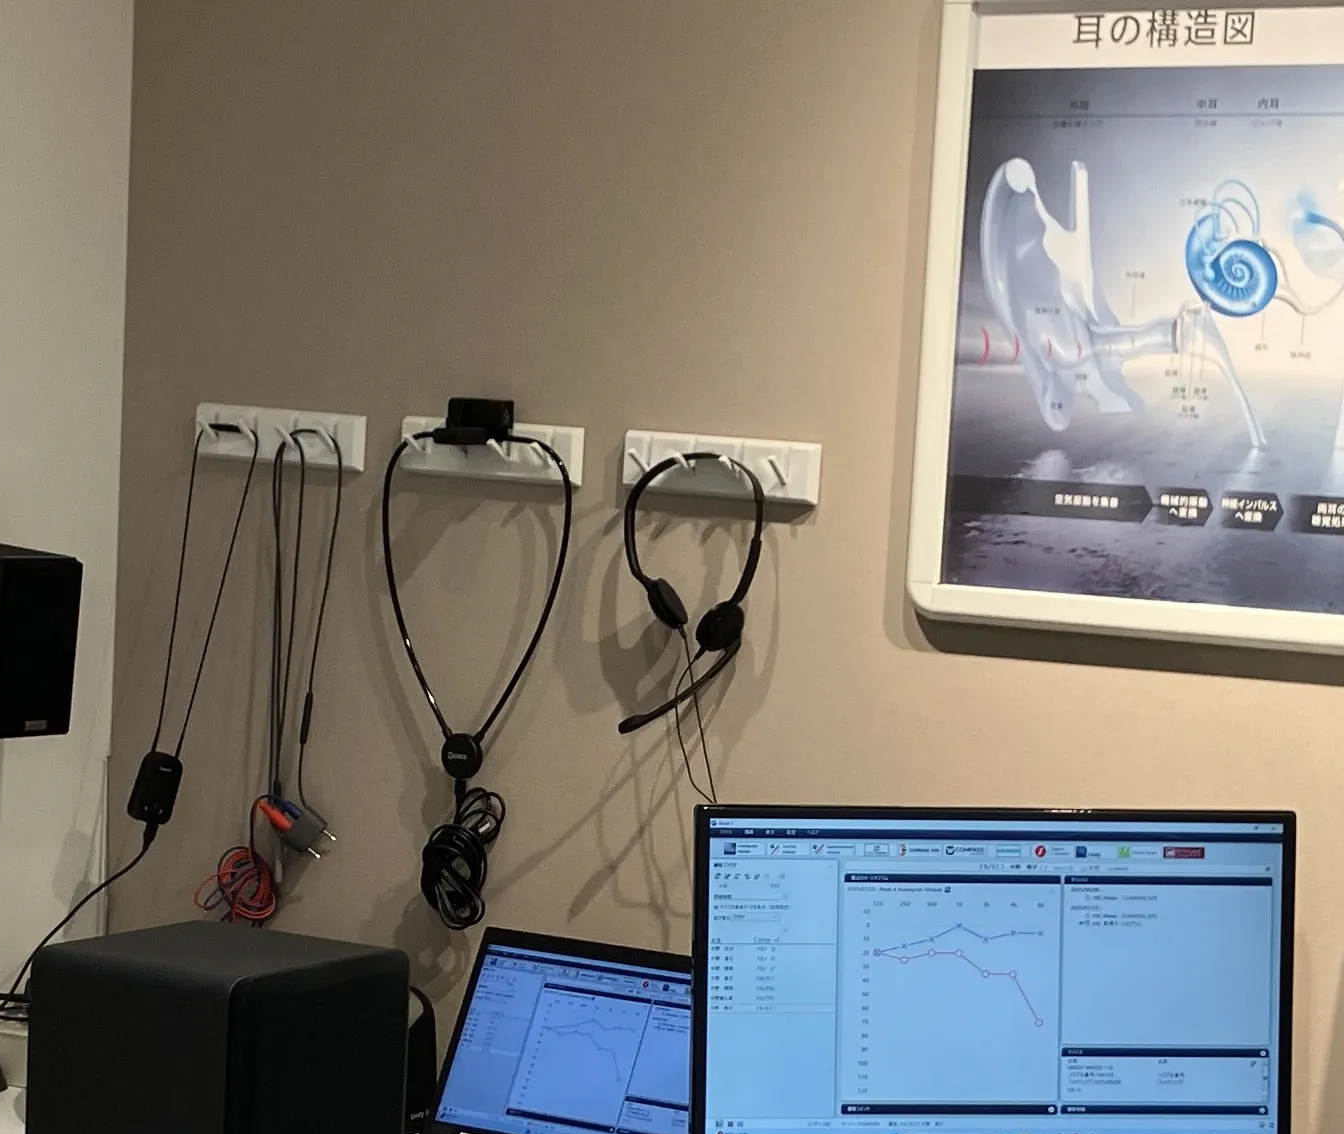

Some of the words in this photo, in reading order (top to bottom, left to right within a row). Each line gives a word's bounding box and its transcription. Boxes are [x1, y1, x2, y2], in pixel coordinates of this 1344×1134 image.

[1072, 8, 1256, 48] 耳の構造図
